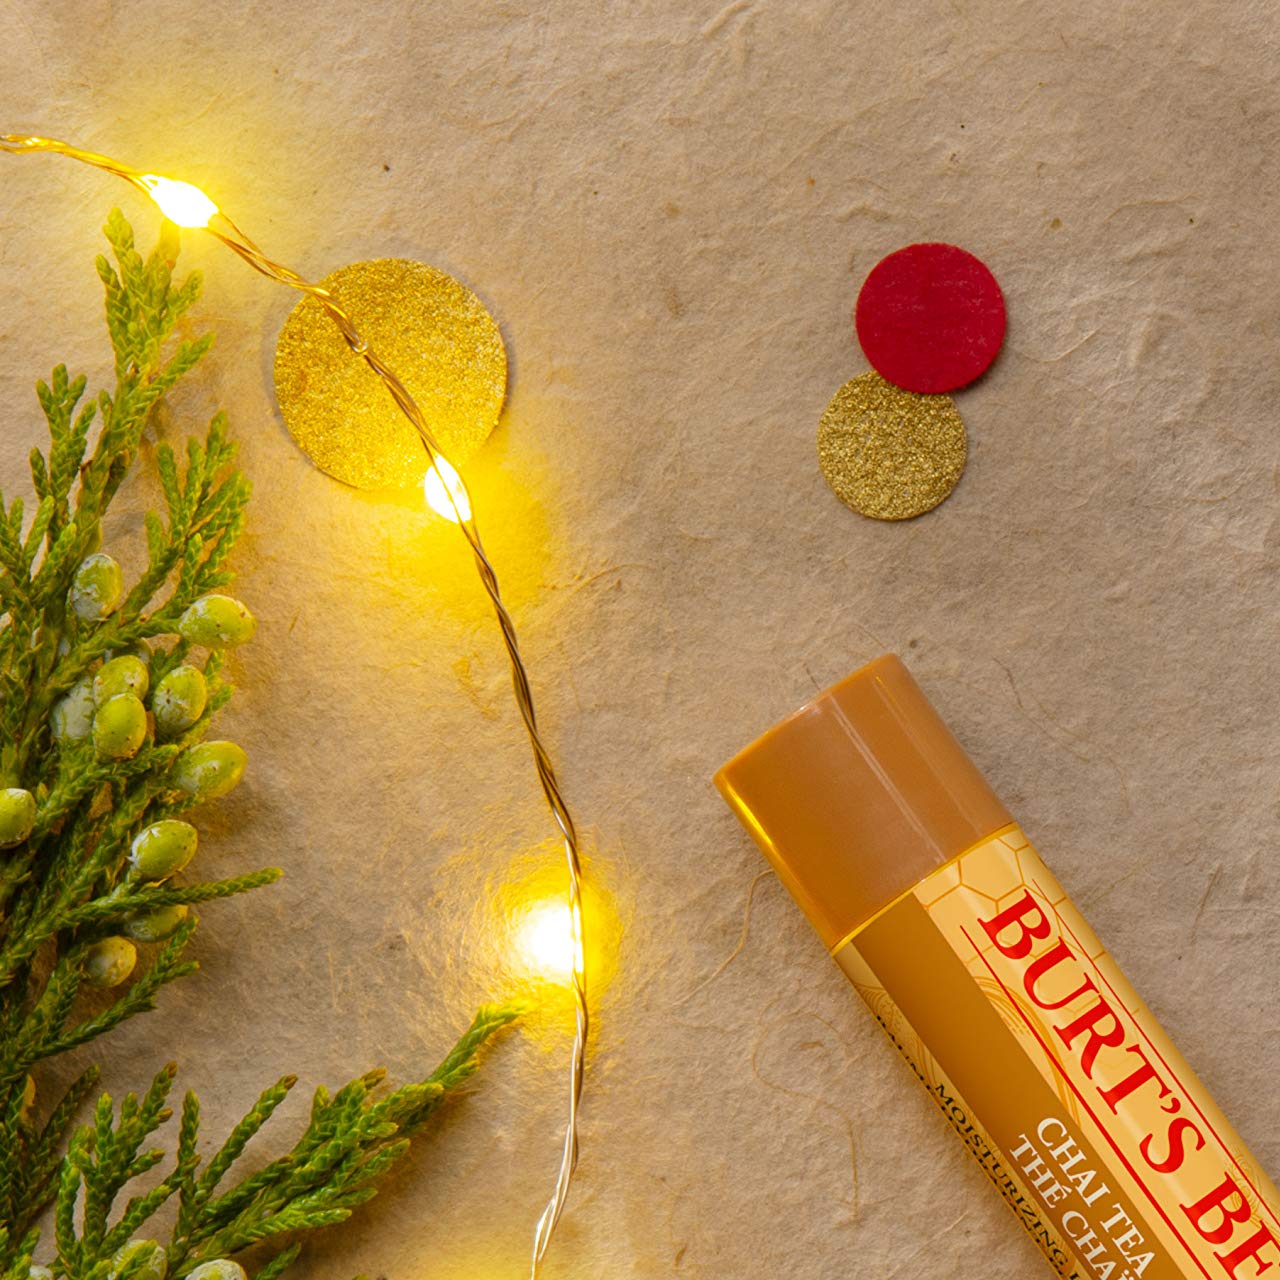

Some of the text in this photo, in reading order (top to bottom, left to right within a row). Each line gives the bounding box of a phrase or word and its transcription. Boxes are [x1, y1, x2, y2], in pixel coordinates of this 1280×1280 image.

[977, 888, 1206, 1174] BURT'S
[935, 1083, 1069, 1266] MOISTURIZING
[1010, 1133, 1073, 1209] THÉ
[1037, 1117, 1155, 1279] CHAI TEA
